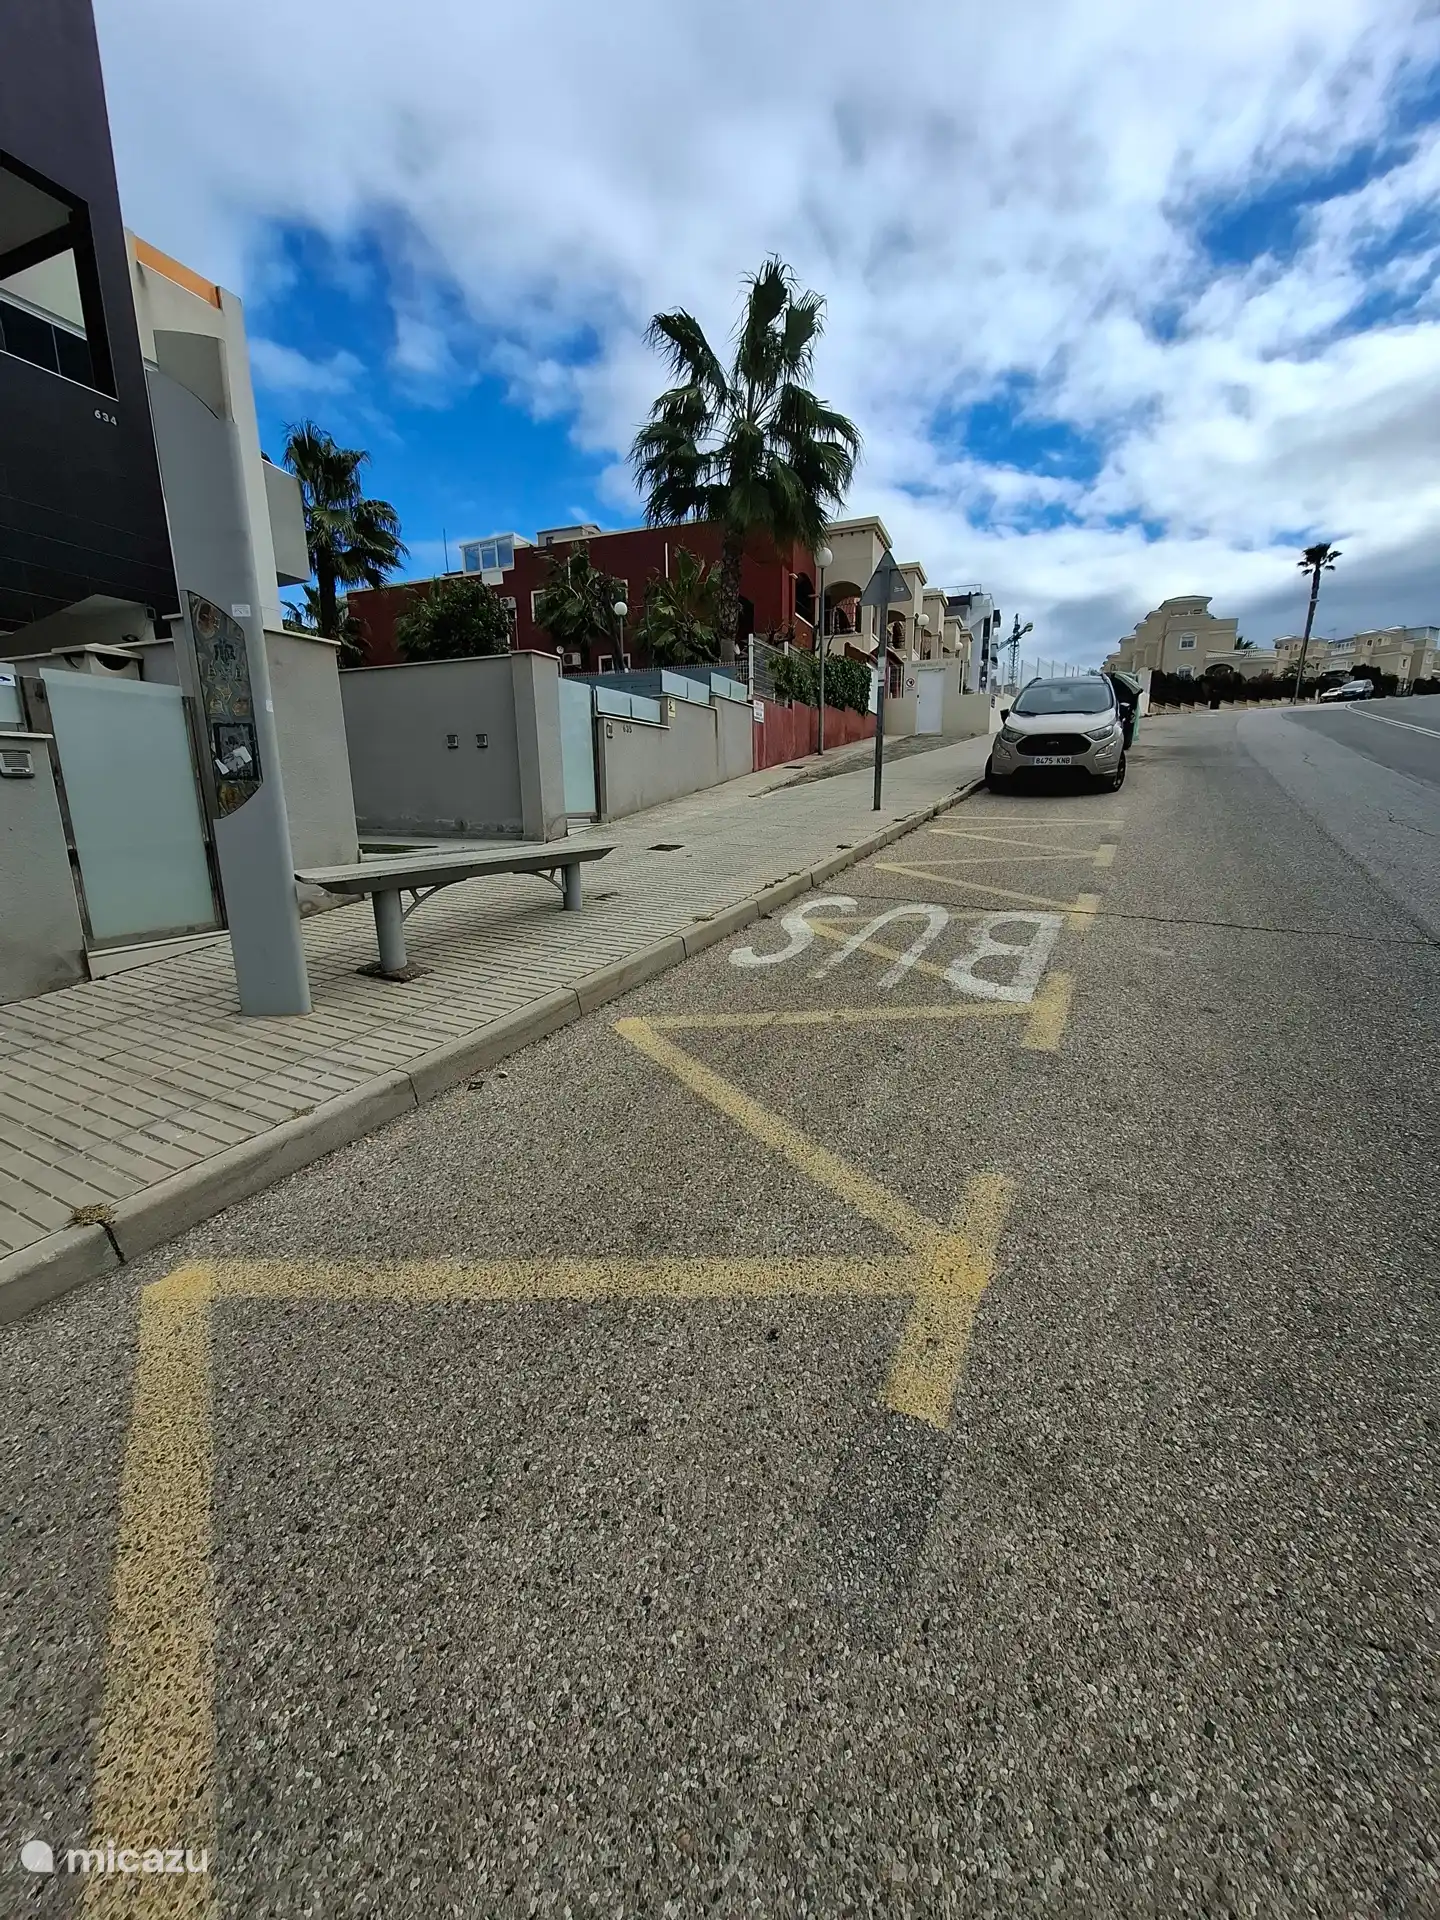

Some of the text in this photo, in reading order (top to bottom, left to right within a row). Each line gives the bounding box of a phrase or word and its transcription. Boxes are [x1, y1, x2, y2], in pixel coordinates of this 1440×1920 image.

[94, 409, 117, 426] 634
[1035, 757, 1054, 765] 8475
[728, 896, 1065, 1003] BUS
